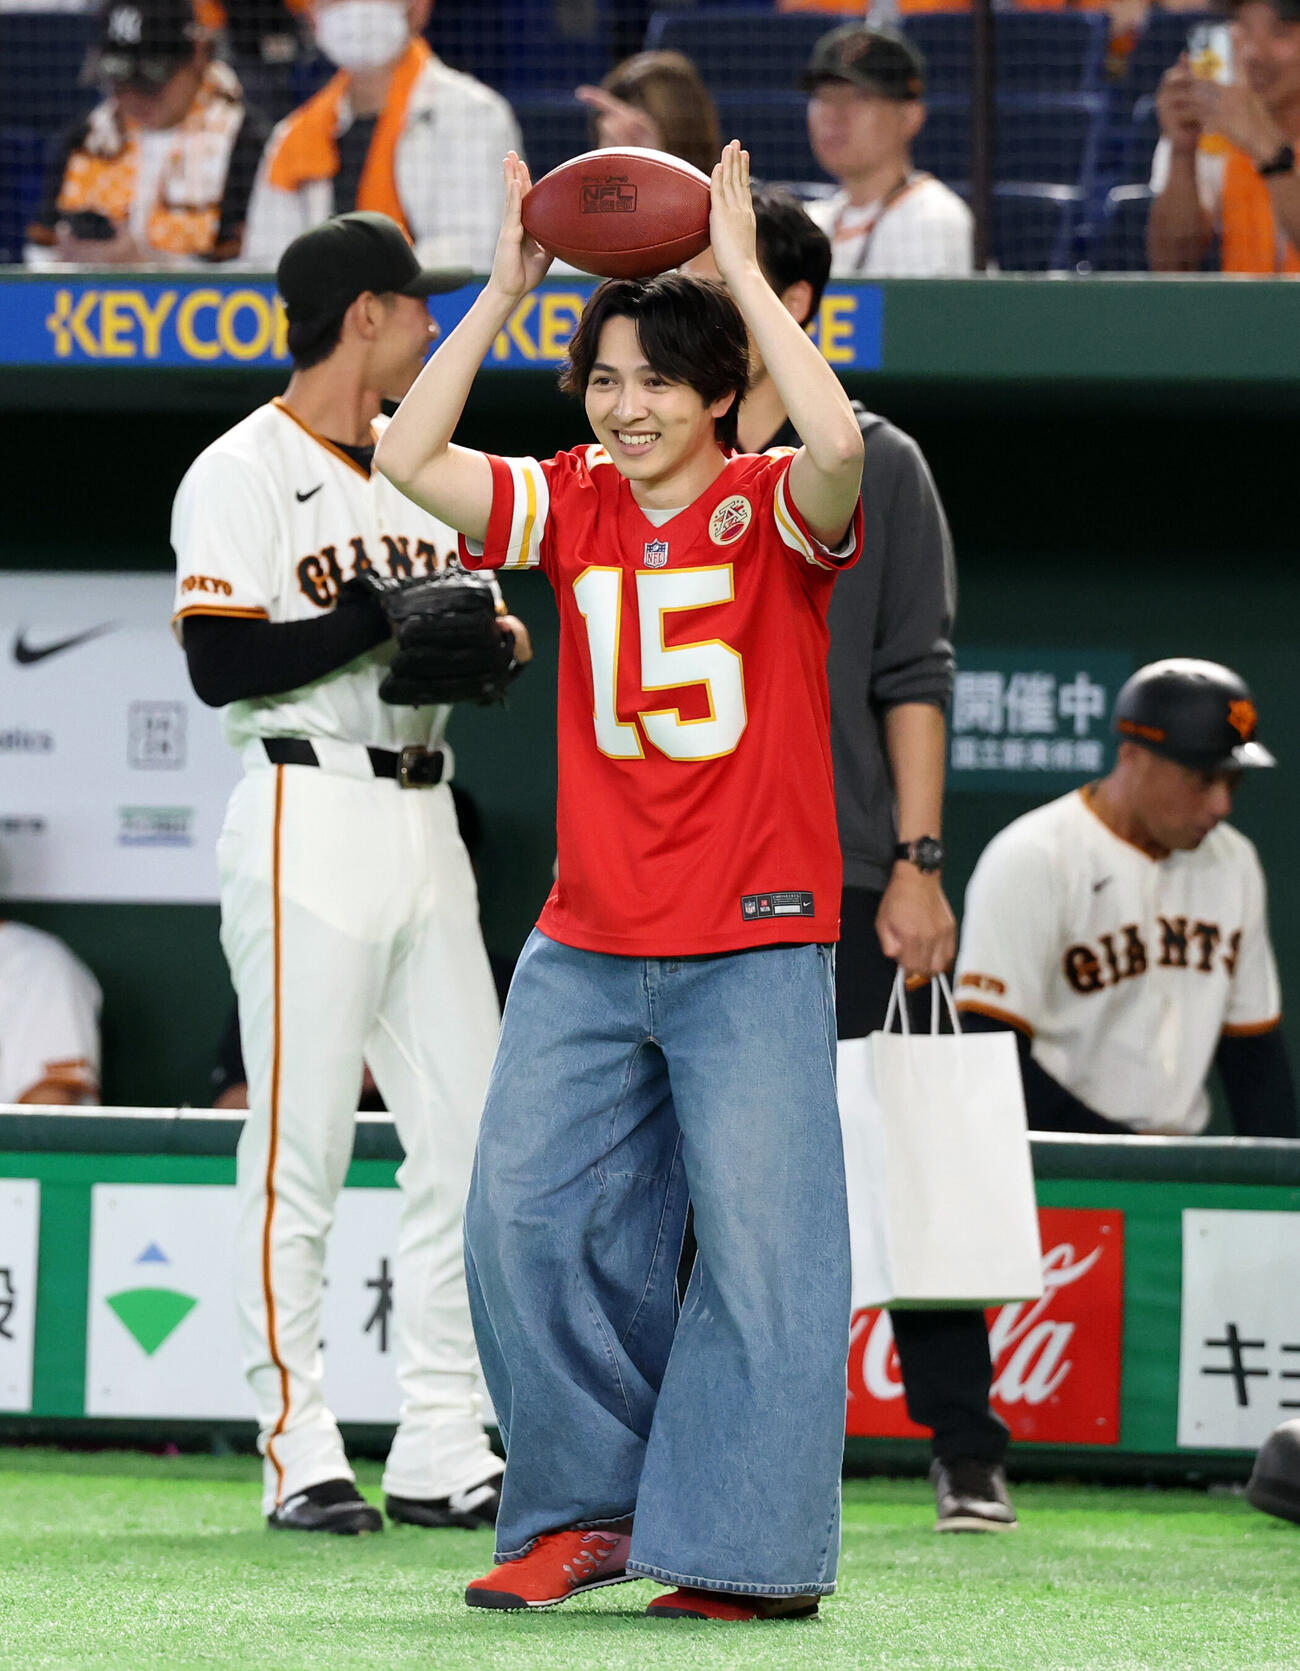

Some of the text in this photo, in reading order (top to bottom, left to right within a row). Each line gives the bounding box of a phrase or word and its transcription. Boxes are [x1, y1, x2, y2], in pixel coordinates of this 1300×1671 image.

[583, 186, 634, 202] NFL
[646, 552, 664, 565] NFL
[572, 563, 748, 762] 15
[952, 670, 1105, 736] 開催中
